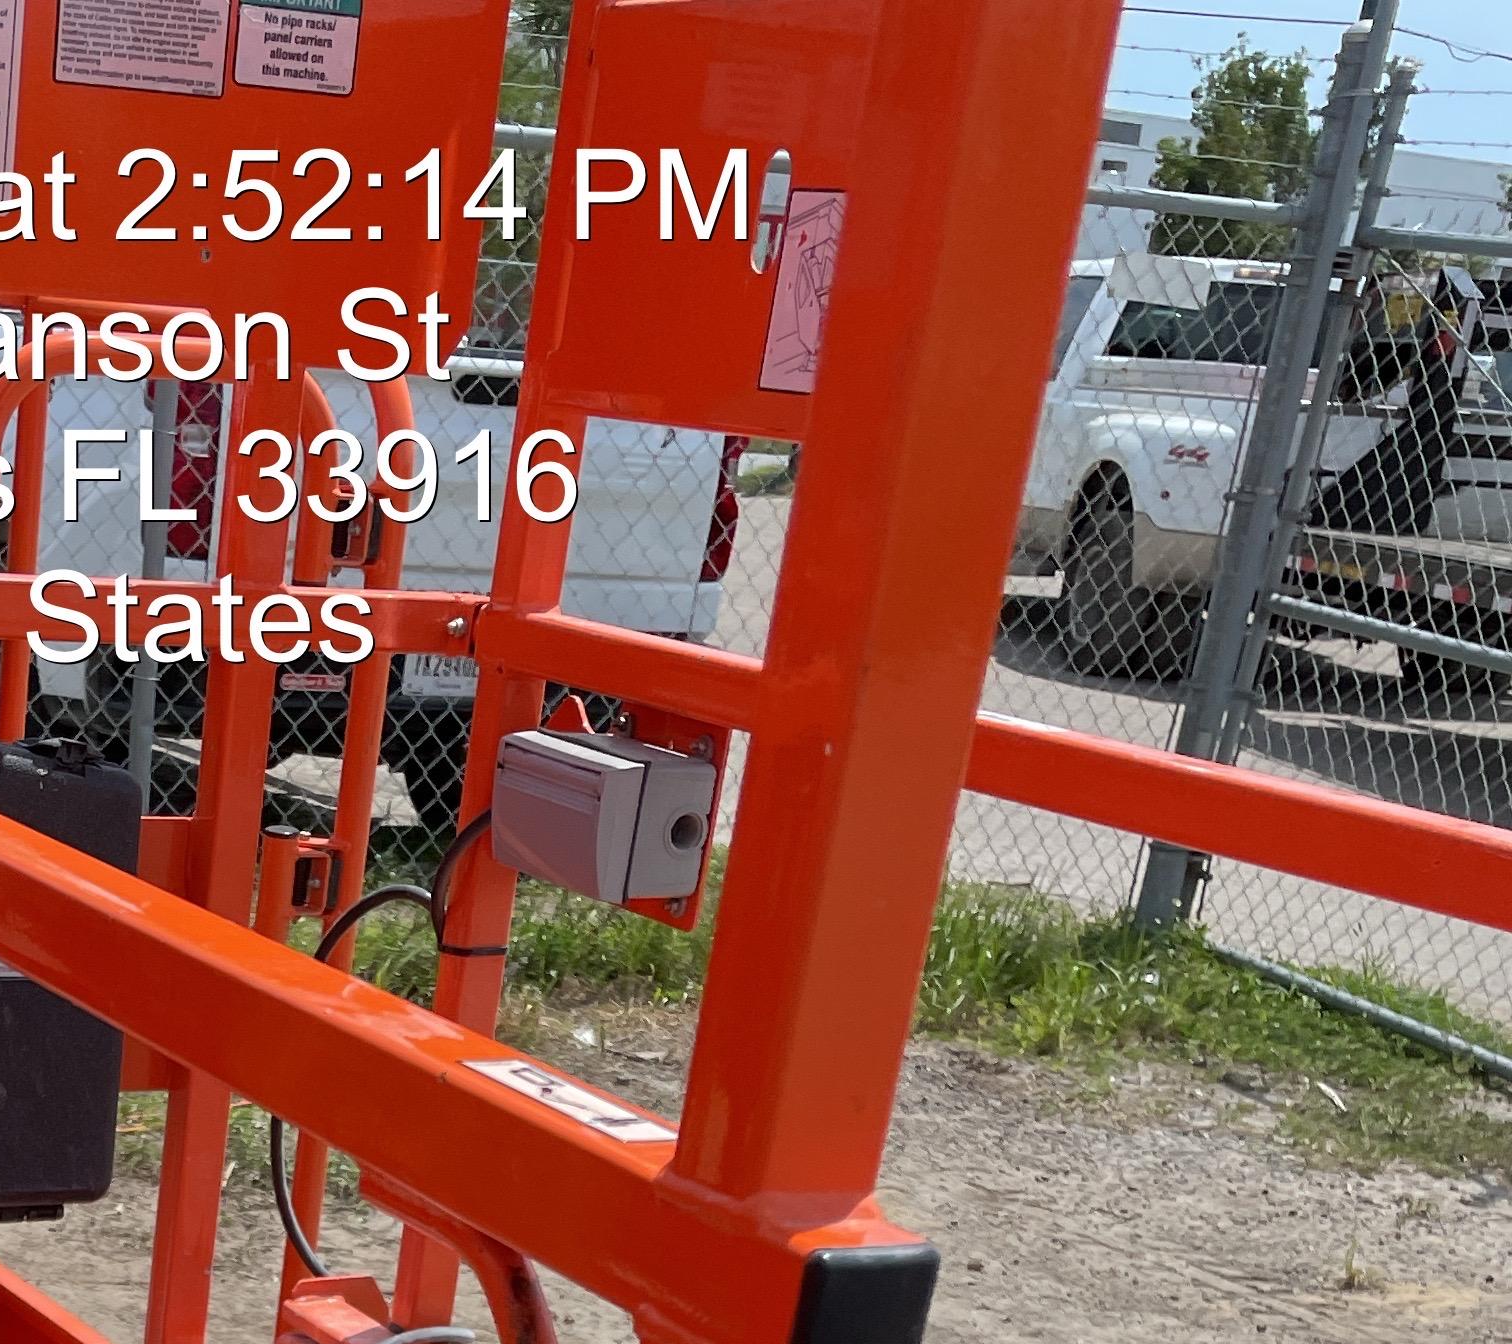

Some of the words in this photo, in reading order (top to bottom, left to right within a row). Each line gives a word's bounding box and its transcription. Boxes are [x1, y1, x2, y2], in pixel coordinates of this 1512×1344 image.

[264, 11, 278, 24] No
[281, 14, 303, 30] pipe
[306, 19, 337, 31] racks/
[264, 31, 292, 44] panel
[294, 35, 333, 48] carriers
[270, 48, 309, 62] allowed
[311, 55, 324, 64] on
[262, 63, 280, 76] this
[283, 67, 328, 81] machine.
